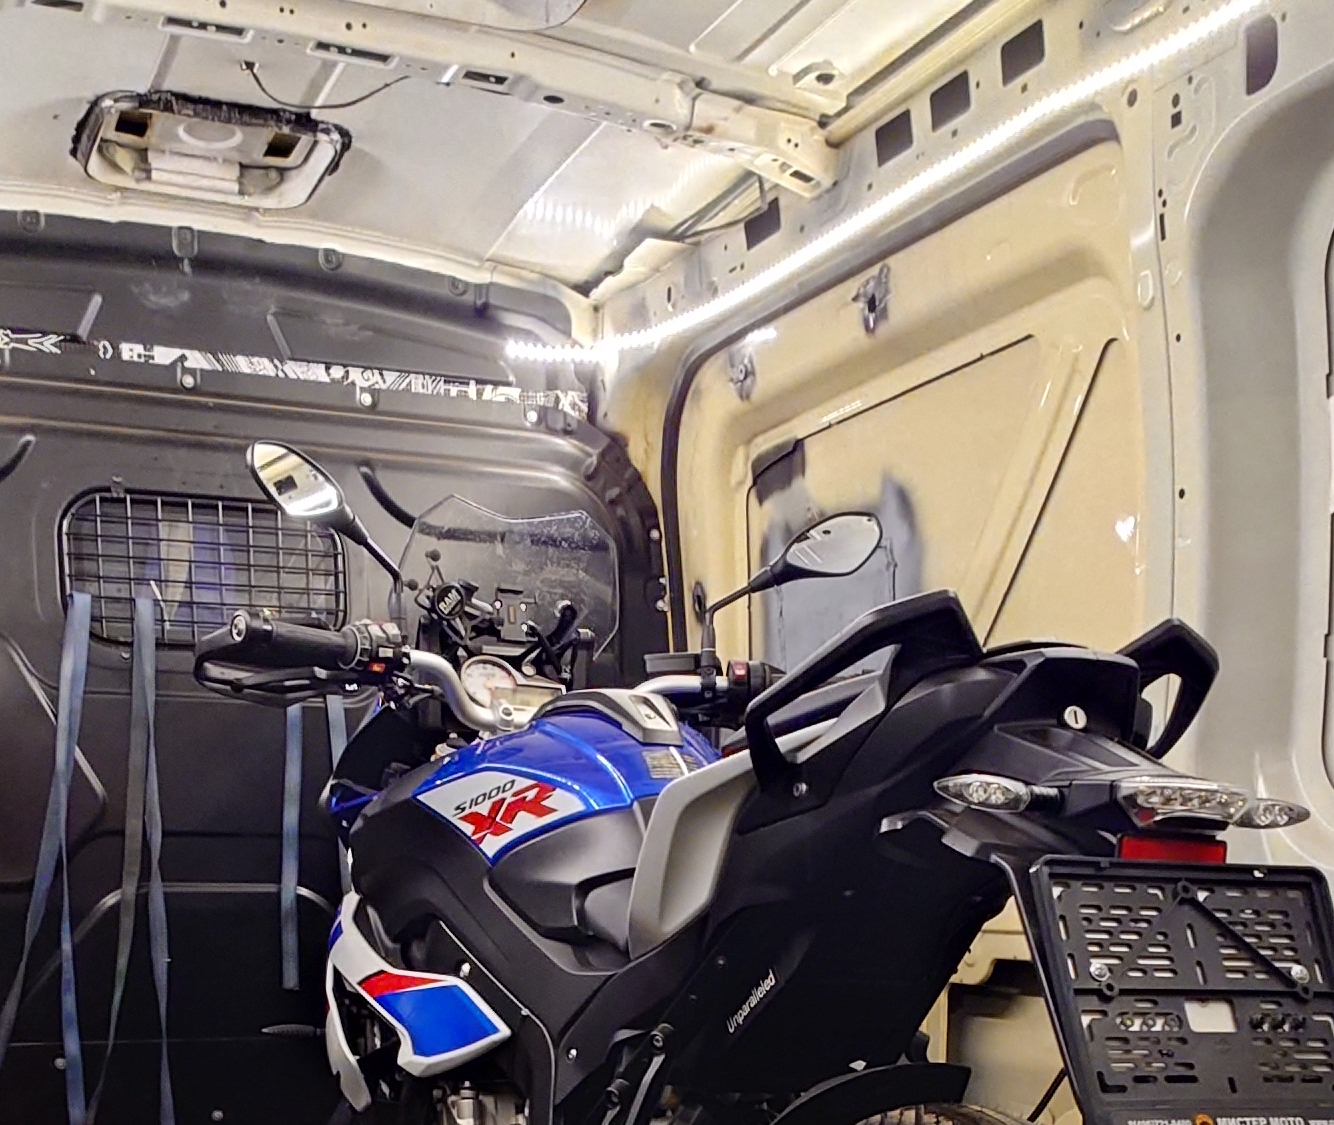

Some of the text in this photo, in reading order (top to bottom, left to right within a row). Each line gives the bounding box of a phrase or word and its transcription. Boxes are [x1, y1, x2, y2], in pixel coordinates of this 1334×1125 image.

[453, 779, 515, 816] S1000
[457, 781, 557, 845] XR
[726, 968, 775, 1033] Unparalleled
